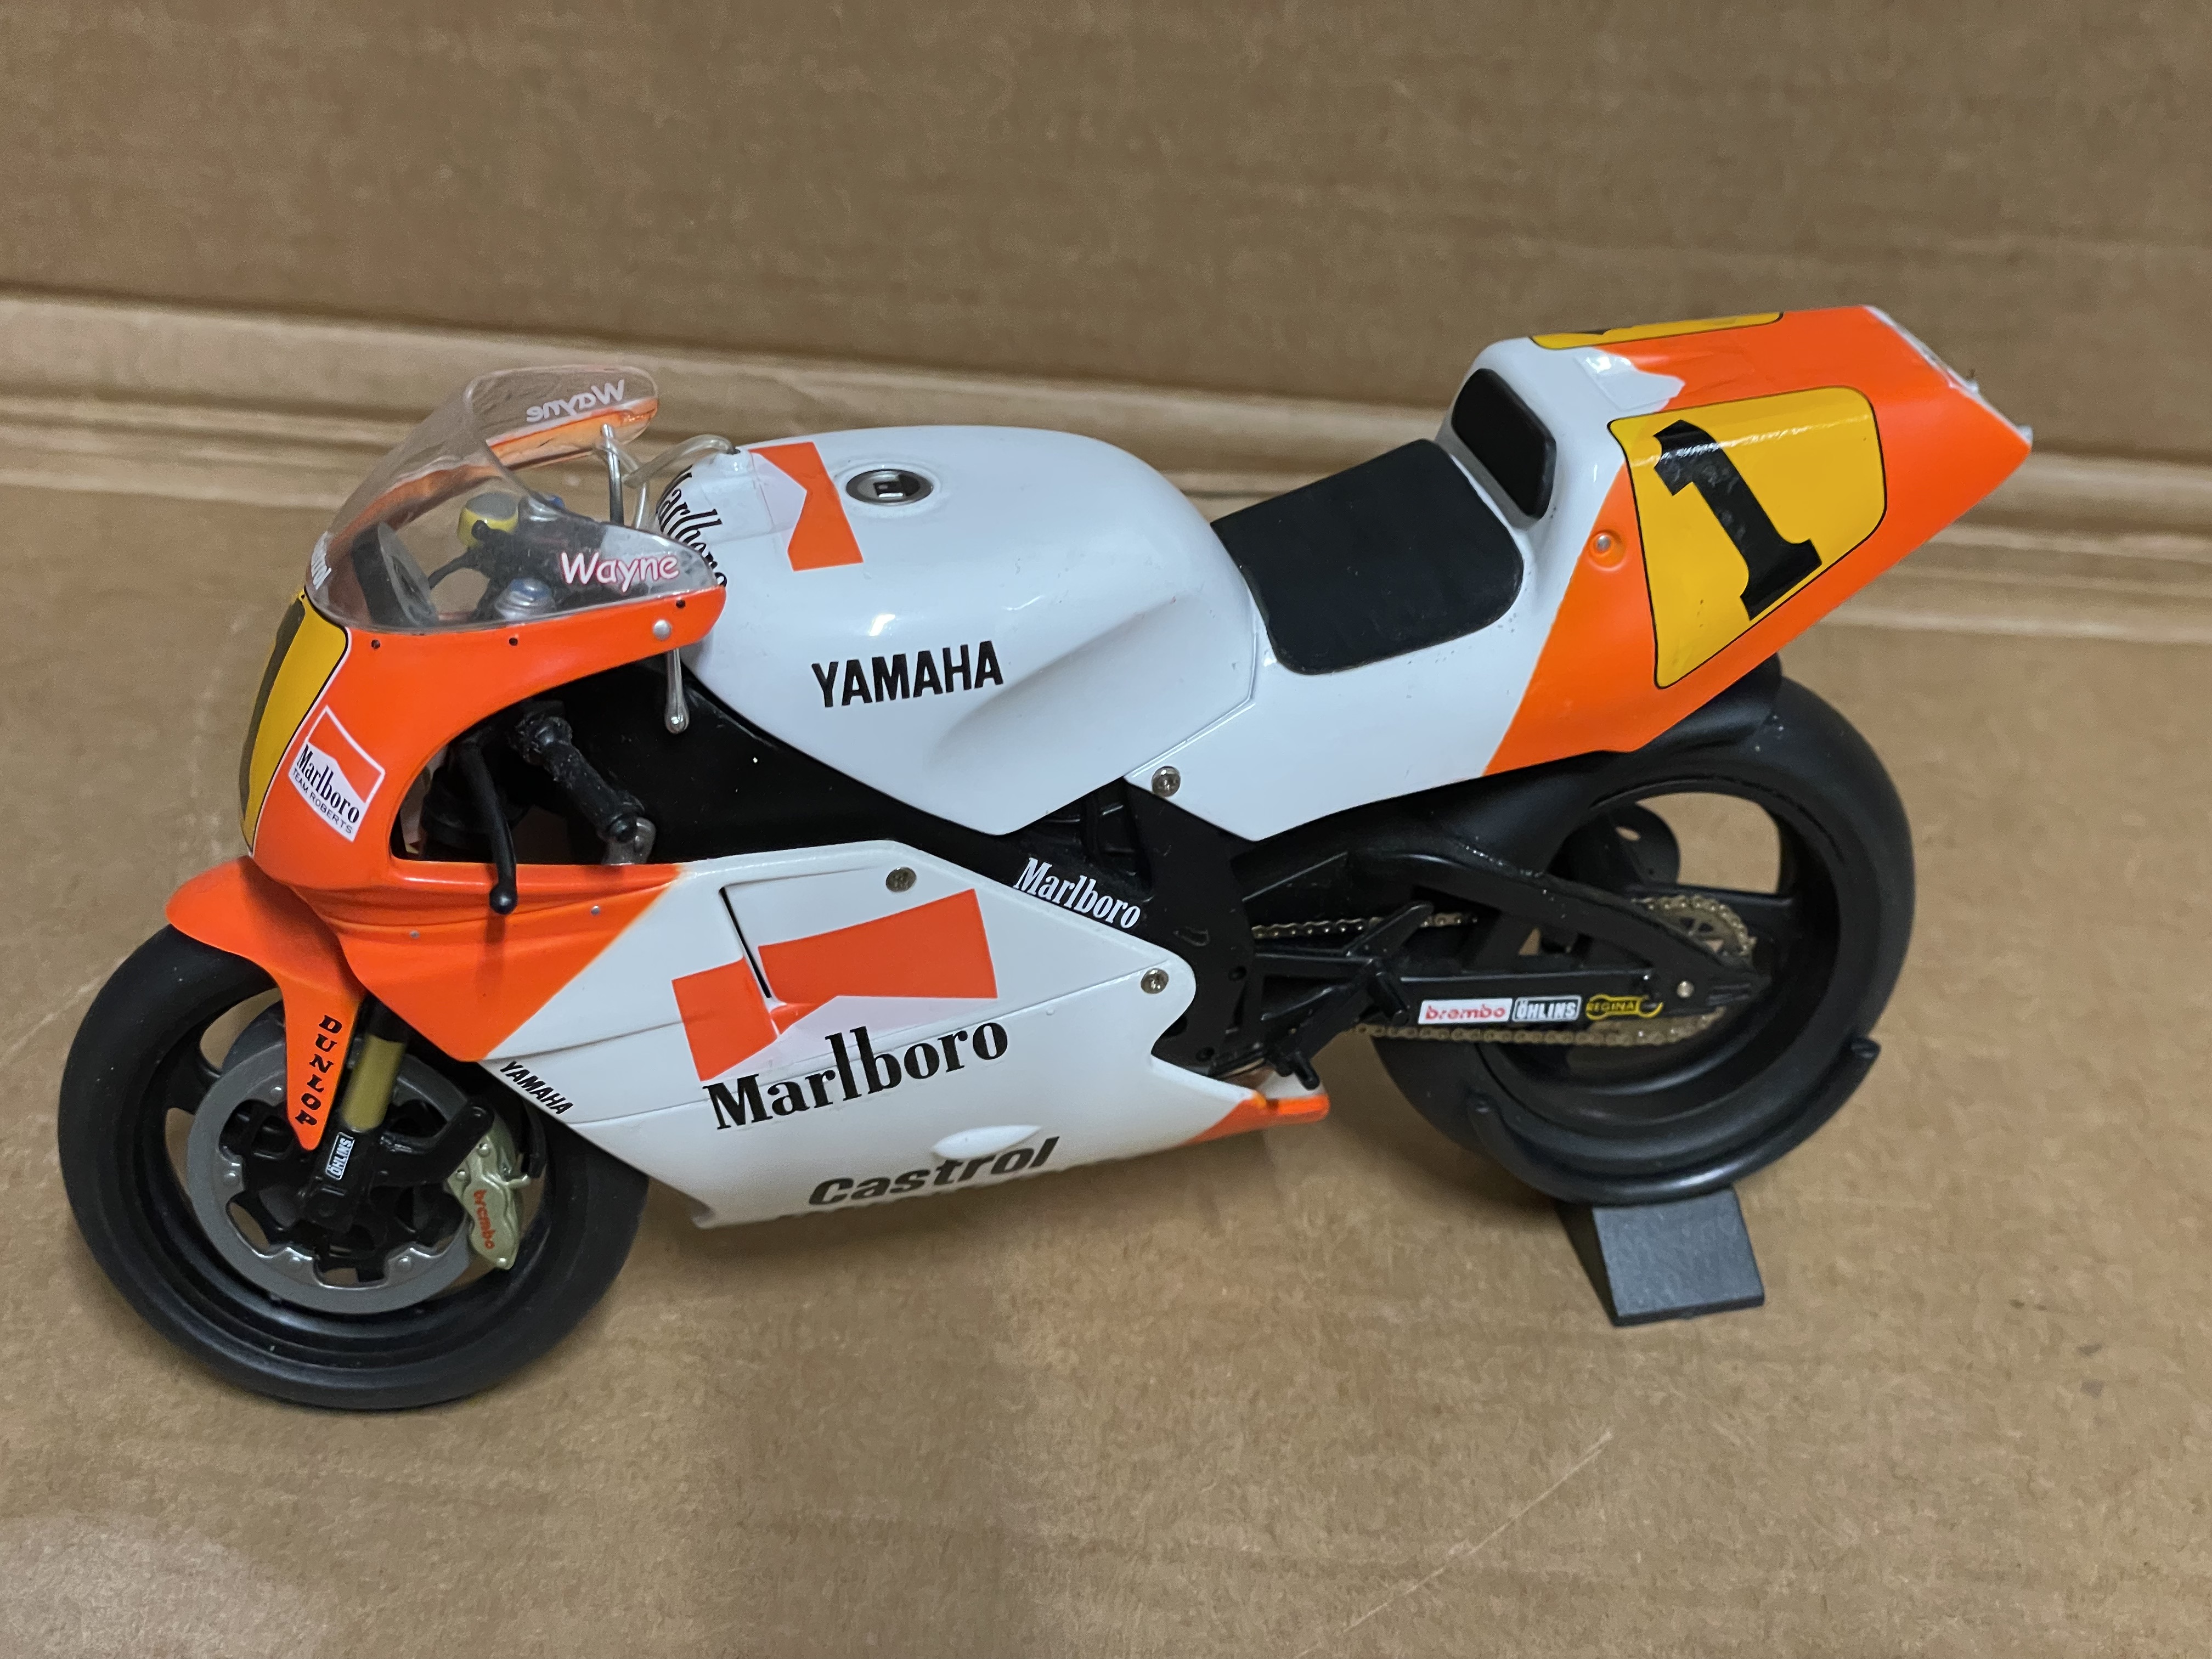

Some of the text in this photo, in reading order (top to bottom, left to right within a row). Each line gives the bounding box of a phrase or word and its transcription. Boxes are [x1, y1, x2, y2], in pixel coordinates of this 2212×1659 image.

[1653, 419, 1822, 621] 1
[560, 552, 681, 592] Wayne
[811, 640, 1003, 708] YAMAHA
[292, 768, 353, 834] TEAM ROBERTS
[297, 743, 360, 823] Marlboro
[1013, 857, 1141, 929] Marlboro
[1425, 1005, 1506, 1019] brembo
[1516, 998, 1577, 1018] ÖHLINS
[295, 1015, 342, 1127] DUNLOP
[500, 1060, 573, 1115] YAMAHA
[703, 1022, 1008, 1130] Marlboro
[809, 1136, 1059, 1206] Castrol
[473, 1189, 495, 1250] brembo
